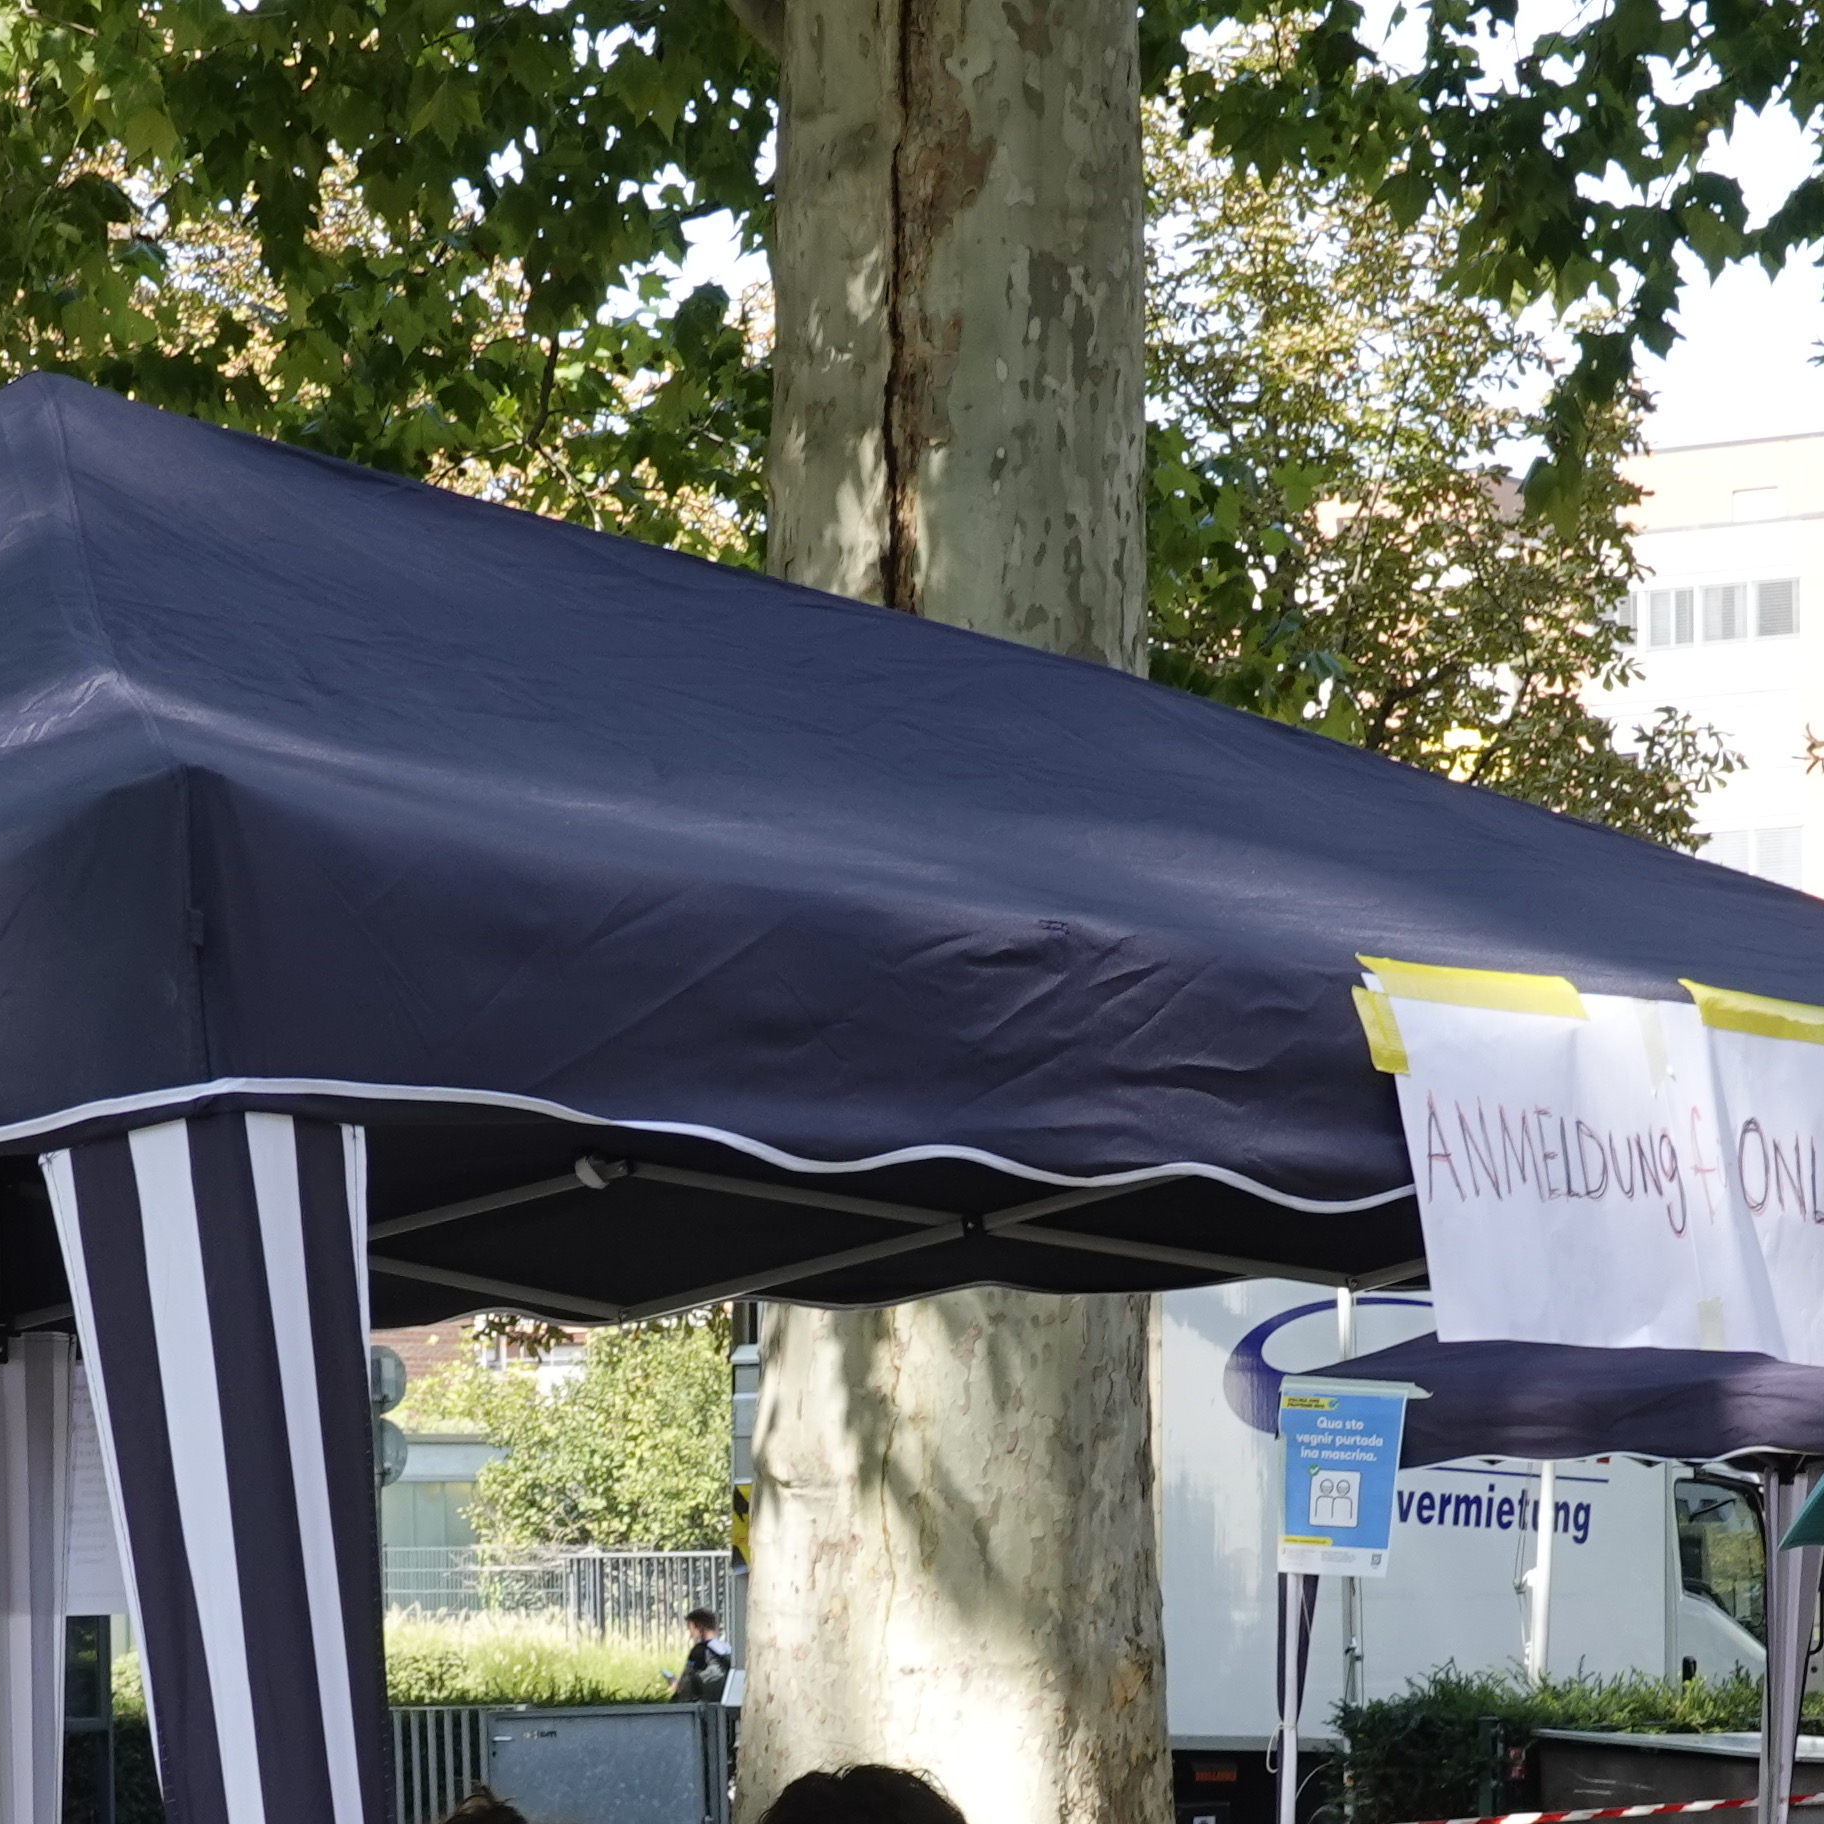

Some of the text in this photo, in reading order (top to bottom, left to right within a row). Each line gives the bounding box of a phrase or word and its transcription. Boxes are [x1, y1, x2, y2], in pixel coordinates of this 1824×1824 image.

[1316, 1416, 1364, 1430] Qua sto
[1296, 1431, 1384, 1448] vegnir purtada
[1300, 1446, 1377, 1462] ina mascrina.
